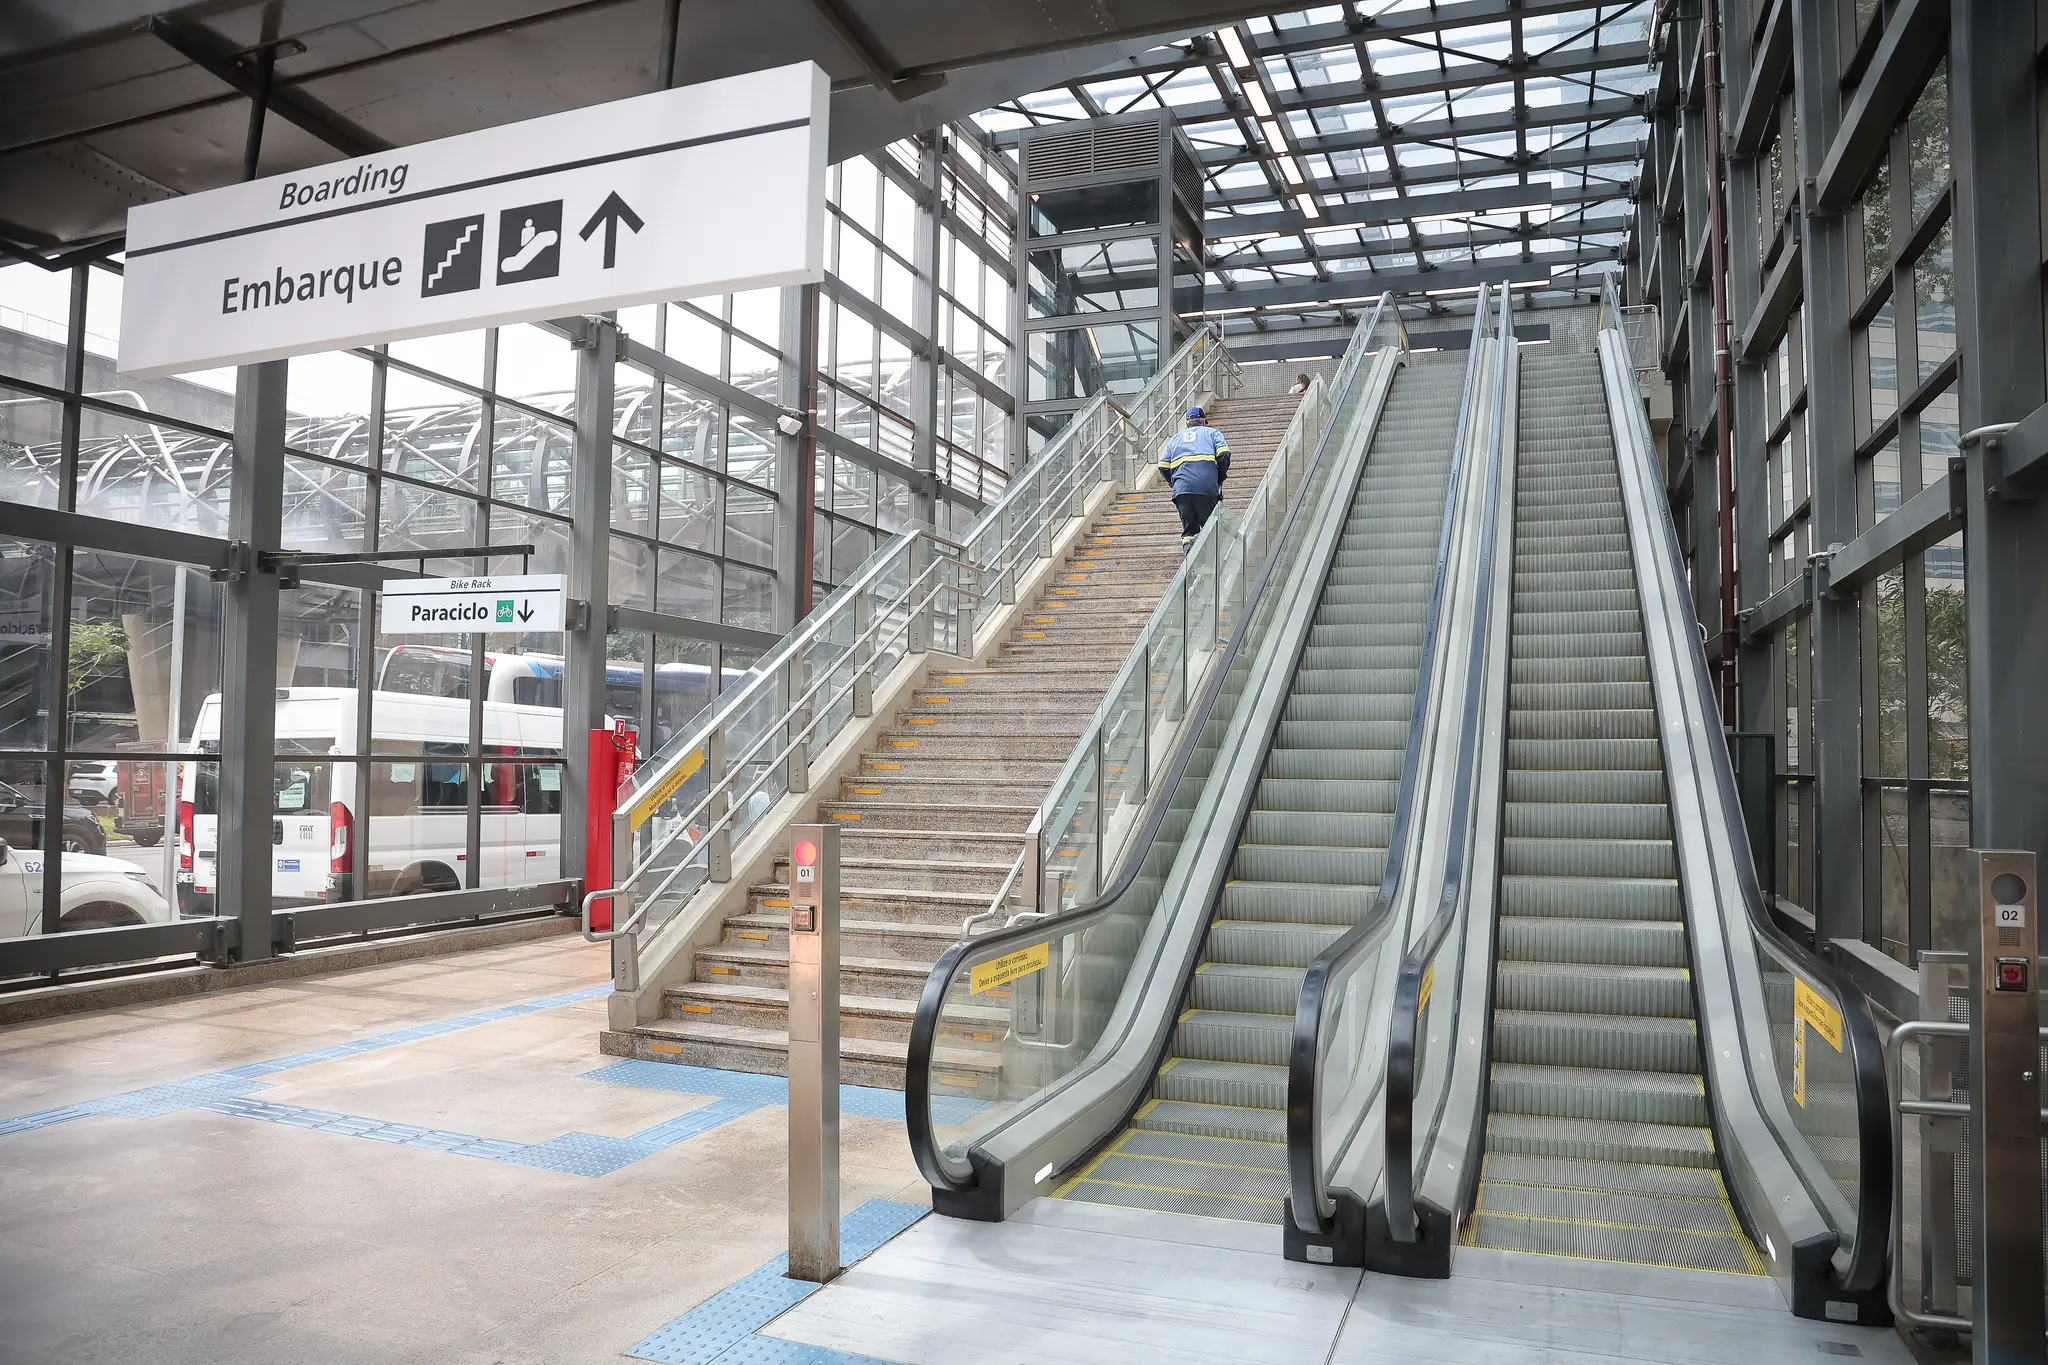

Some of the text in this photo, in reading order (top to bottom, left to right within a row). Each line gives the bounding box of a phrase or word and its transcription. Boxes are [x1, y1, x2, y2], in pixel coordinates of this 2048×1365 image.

[279, 163, 409, 210] Boarding
[222, 256, 402, 315] Embarque
[450, 579, 492, 589] Bike Rack
[411, 602, 489, 621] Paraciclo
[25, 861, 44, 873] 62
[800, 869, 810, 877] 01
[2001, 910, 2018, 921] 02
